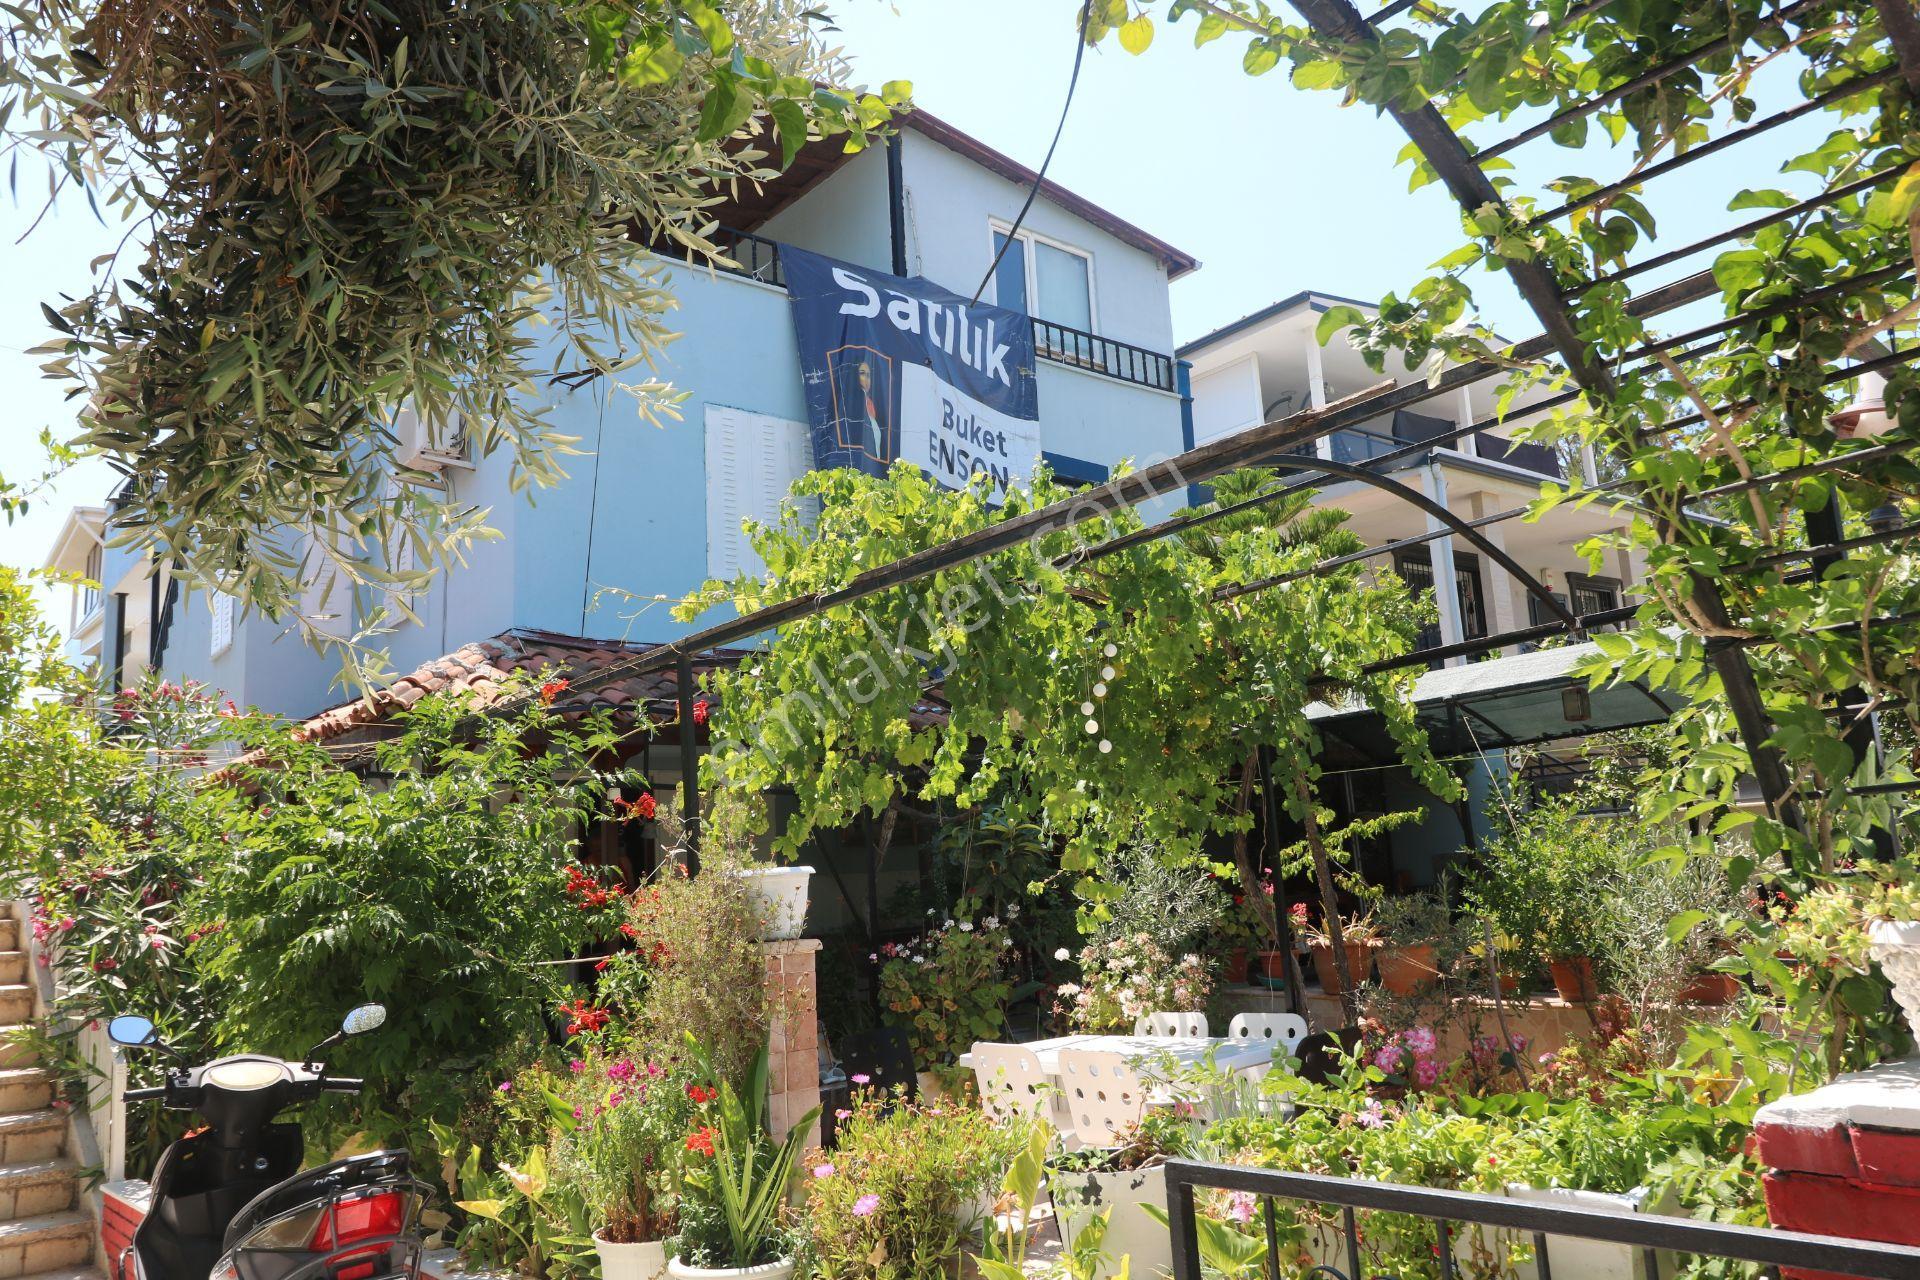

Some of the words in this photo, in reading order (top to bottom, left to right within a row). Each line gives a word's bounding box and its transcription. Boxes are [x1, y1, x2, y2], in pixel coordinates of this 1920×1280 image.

[832, 267, 1011, 388] Satılık
[942, 398, 1008, 458] Buket
[929, 429, 1009, 495] ENSON
